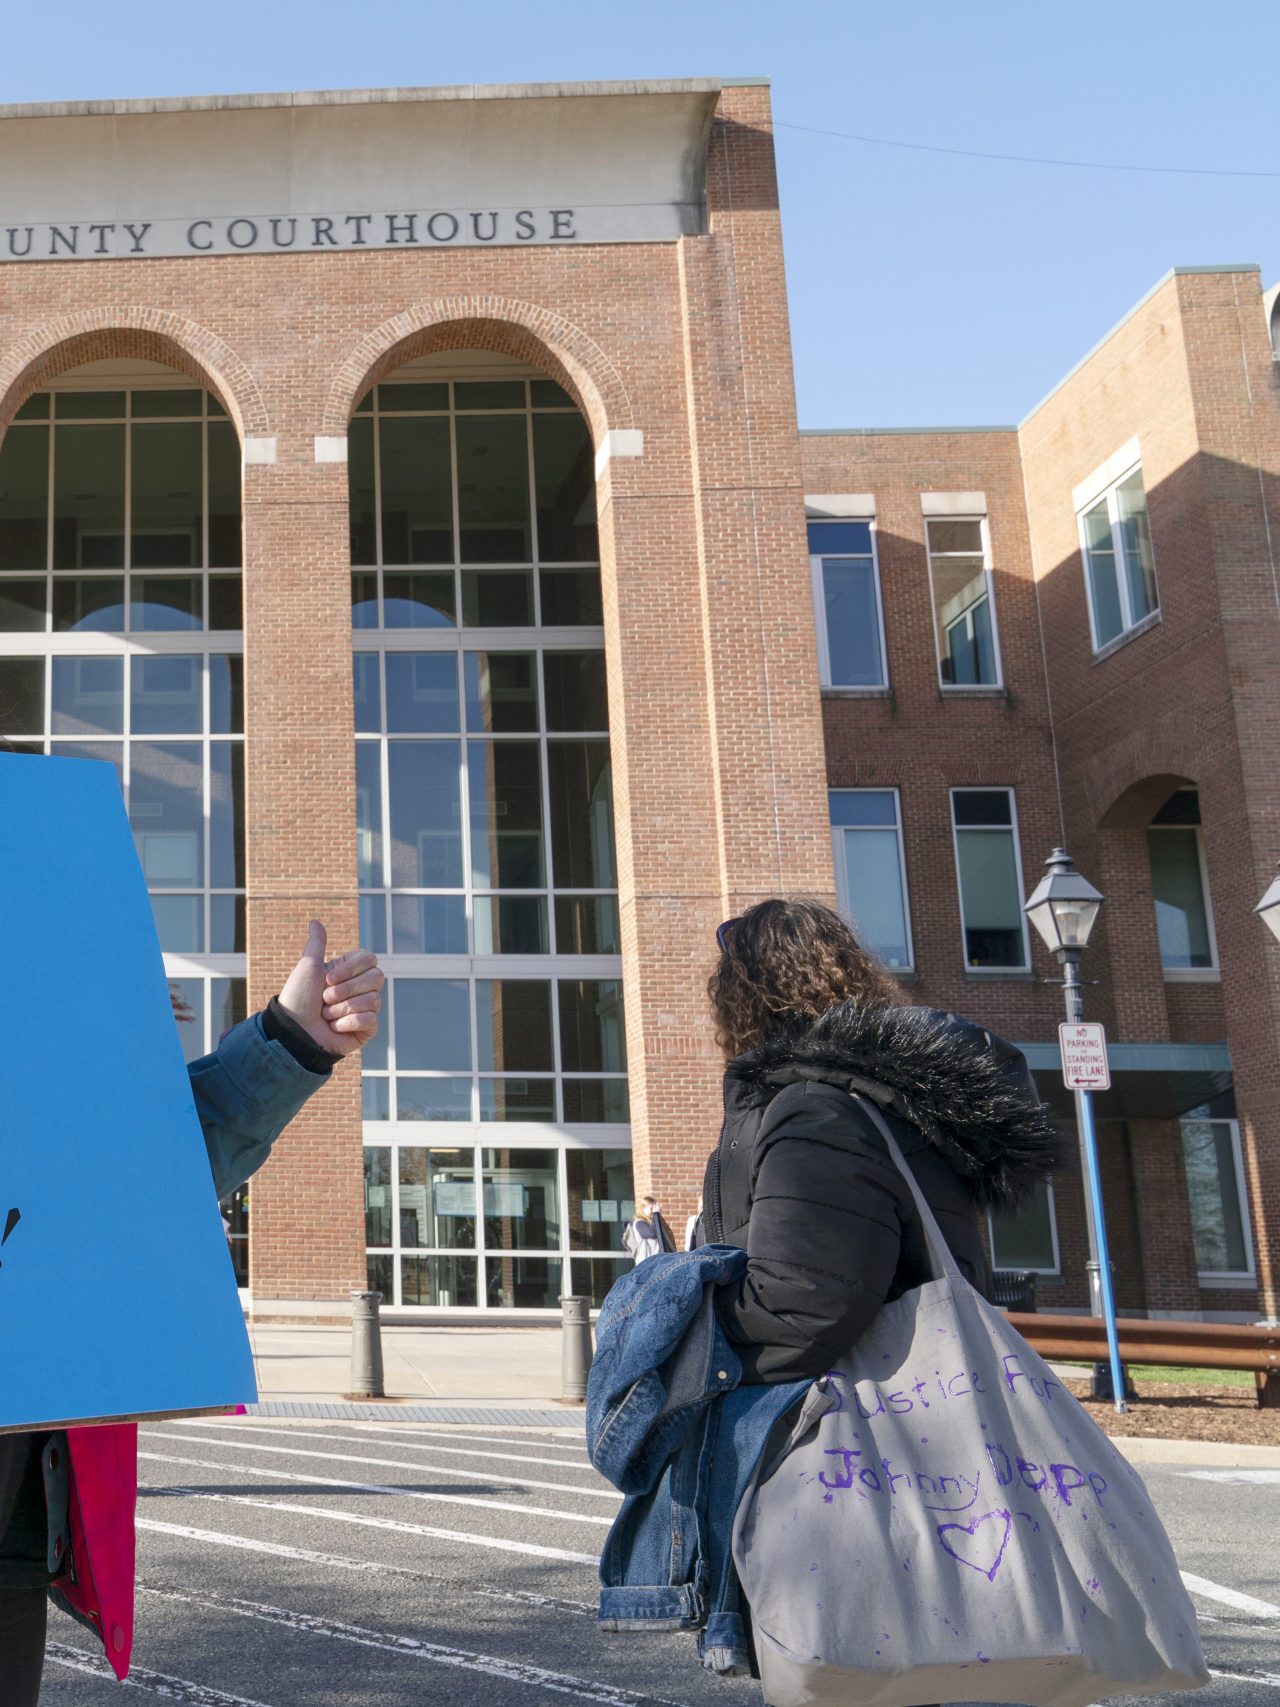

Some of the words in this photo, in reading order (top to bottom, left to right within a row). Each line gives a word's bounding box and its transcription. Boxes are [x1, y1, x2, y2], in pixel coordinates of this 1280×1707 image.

[186, 209, 577, 251] COURTHOUSE
[1076, 1028, 1088, 1038] NO
[1066, 1039, 1100, 1049] PARKING
[1066, 1055, 1104, 1064] STANDING
[1067, 1066, 1083, 1076] FIRE
[1085, 1066, 1105, 1076] LANE
[819, 1370, 986, 1420] Justice
[1002, 1354, 1061, 1404] For
[818, 1449, 981, 1512] Johnny
[985, 1443, 1109, 1508] Depp
